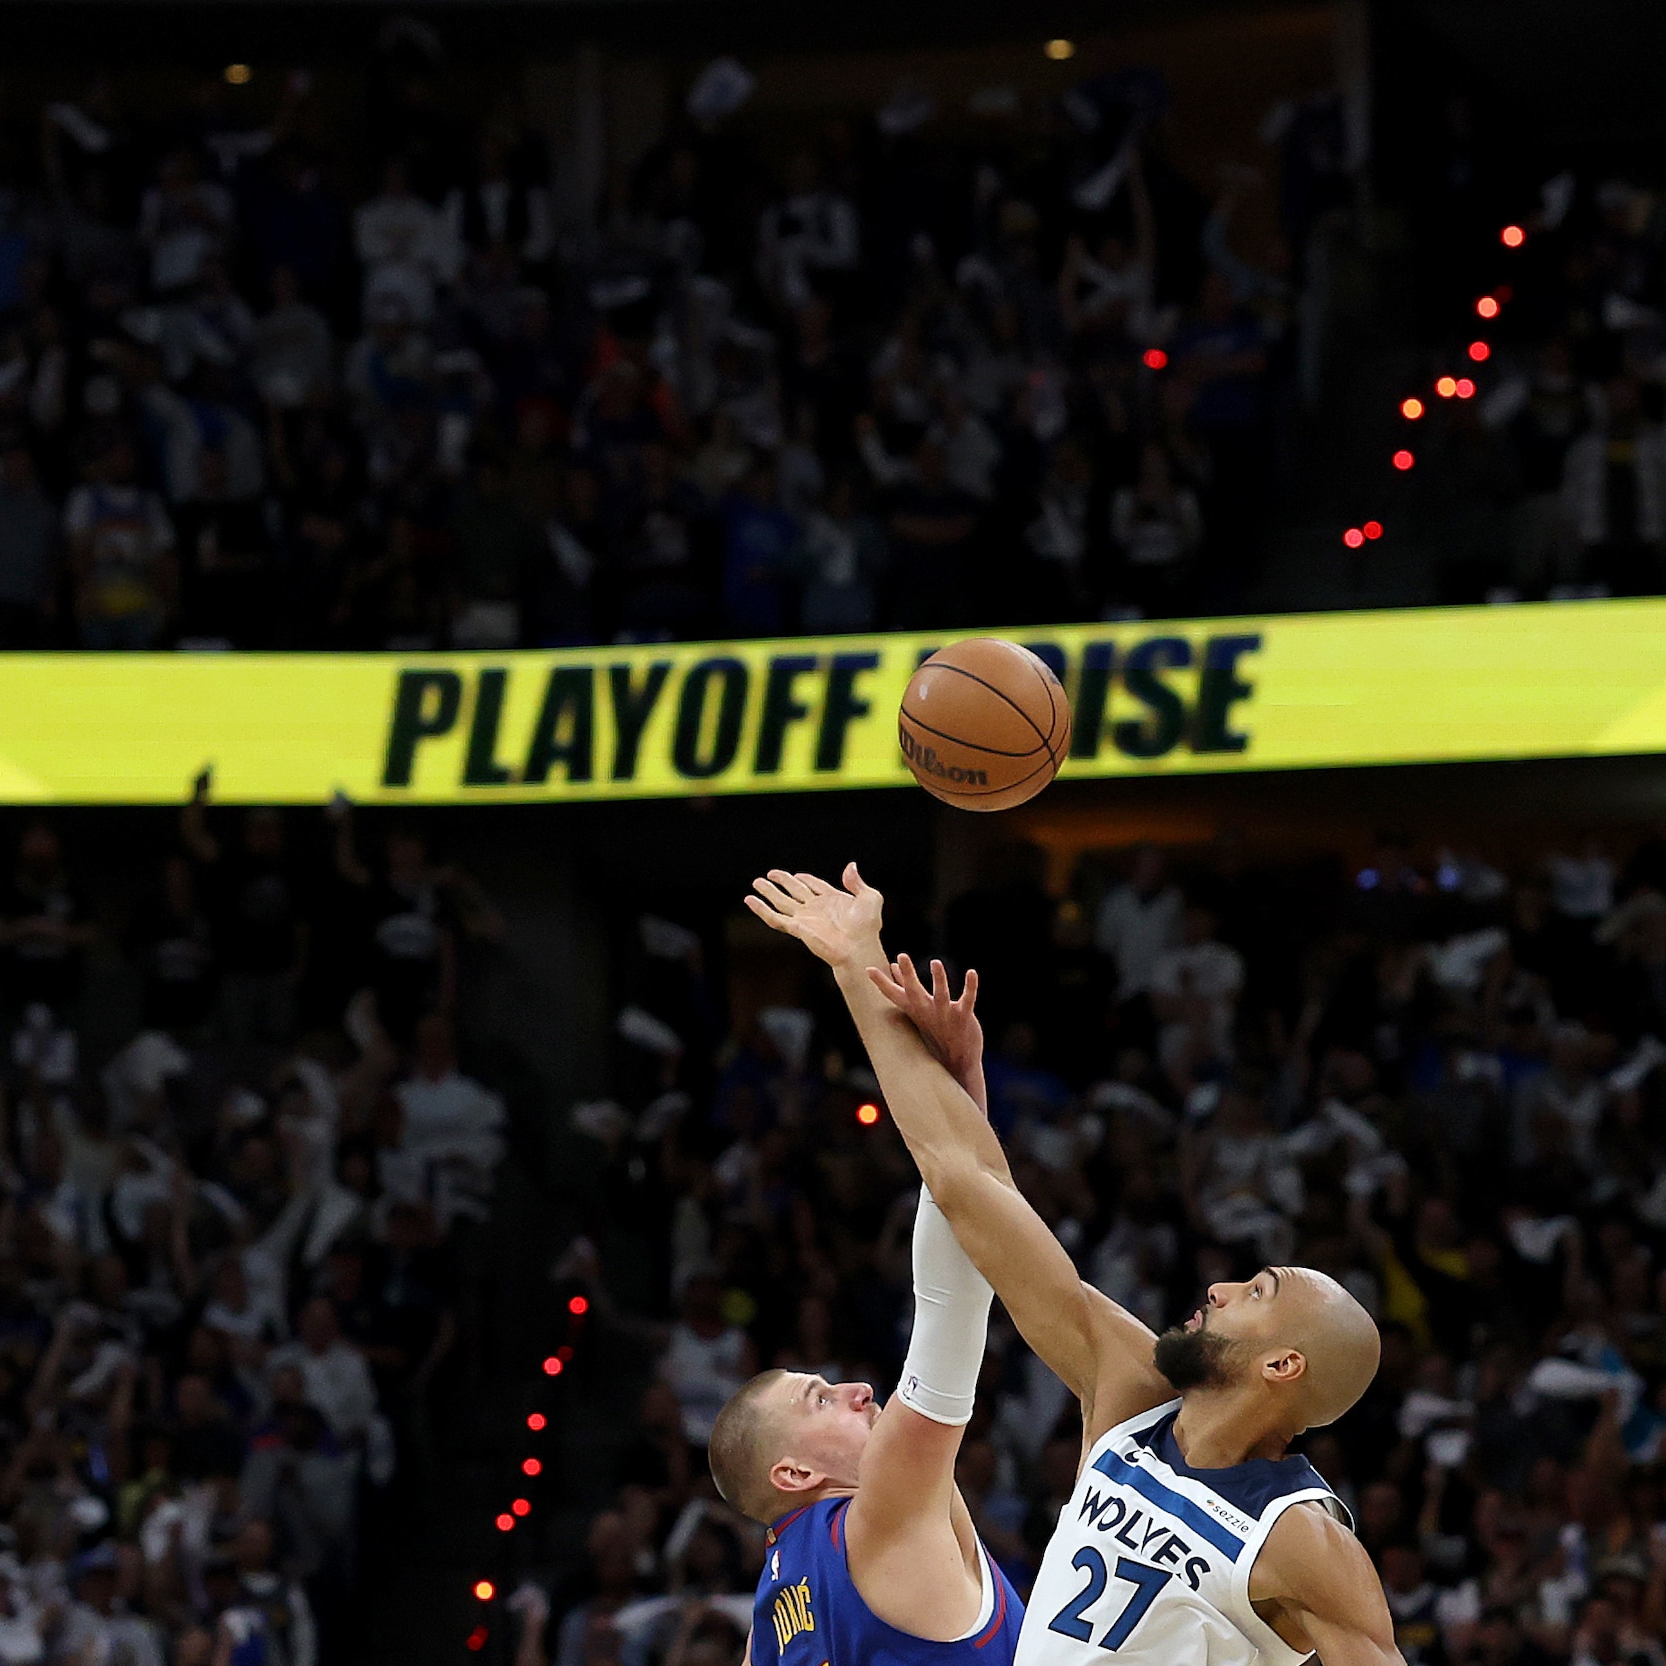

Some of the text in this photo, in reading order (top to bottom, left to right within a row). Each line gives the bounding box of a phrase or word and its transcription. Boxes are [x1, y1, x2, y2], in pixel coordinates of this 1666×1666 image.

[381, 633, 1262, 788] PLAYOFF ISE
[900, 726, 989, 787] Wilson
[1077, 1485, 1211, 1591] WOLVES
[1213, 1503, 1250, 1534] sezzle
[1048, 1545, 1175, 1653] 27
